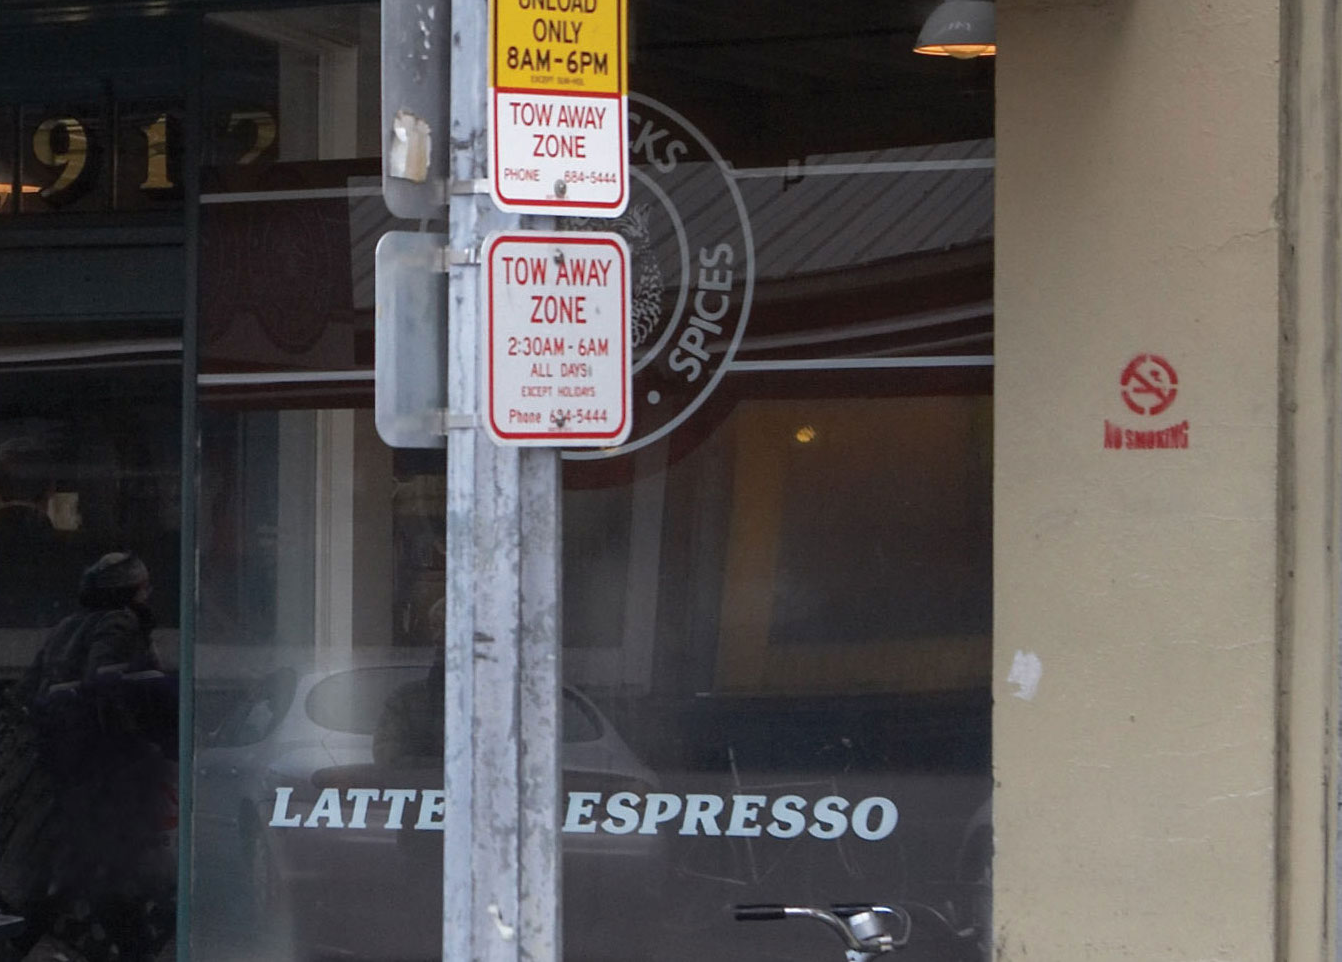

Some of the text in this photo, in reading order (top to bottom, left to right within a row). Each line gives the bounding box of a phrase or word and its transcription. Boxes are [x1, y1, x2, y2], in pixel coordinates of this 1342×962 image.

[533, 18, 583, 44] ONLY
[509, 102, 606, 129] TOW AWAY
[533, 134, 586, 158] ZONE
[504, 167, 540, 182] PHONE
[502, 257, 612, 287] TOW AWAY
[530, 295, 587, 324] ZONE
[668, 242, 735, 383] SPICES
[530, 363, 587, 377] ALL DAYS
[521, 386, 596, 398] EXCEPT HOLIDAYS
[509, 409, 541, 423] Phone
[1104, 419, 1123, 449] NO
[268, 786, 899, 841] LATTE ESPRESSO
